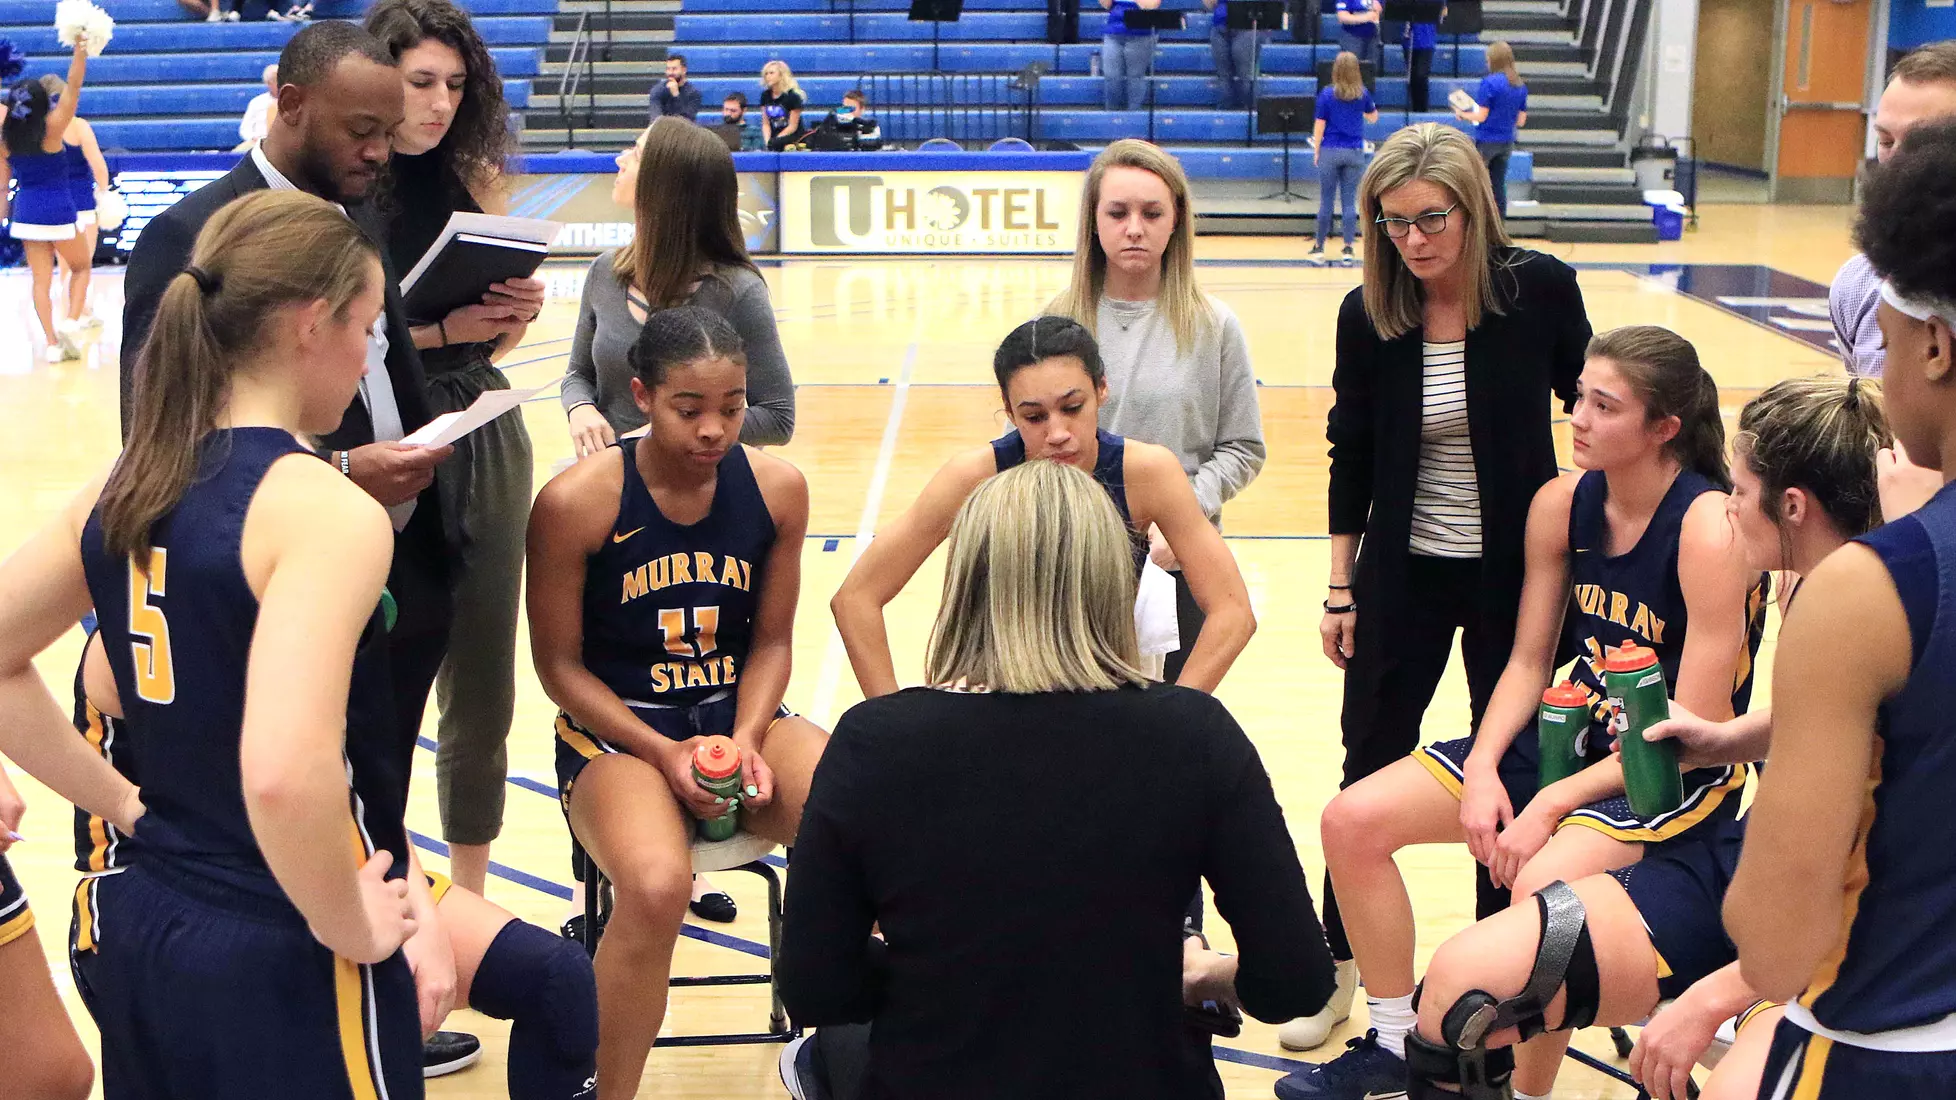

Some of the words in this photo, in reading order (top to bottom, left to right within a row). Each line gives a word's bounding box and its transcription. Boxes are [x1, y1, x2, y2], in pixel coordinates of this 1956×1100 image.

[886, 186, 1059, 230] HOTEL
[886, 235, 962, 247] UNIQUE
[988, 235, 1056, 246] SUITES
[621, 551, 752, 604] MURRAY
[129, 546, 175, 705] 5
[657, 606, 720, 658] 11
[651, 655, 737, 693] STATE
